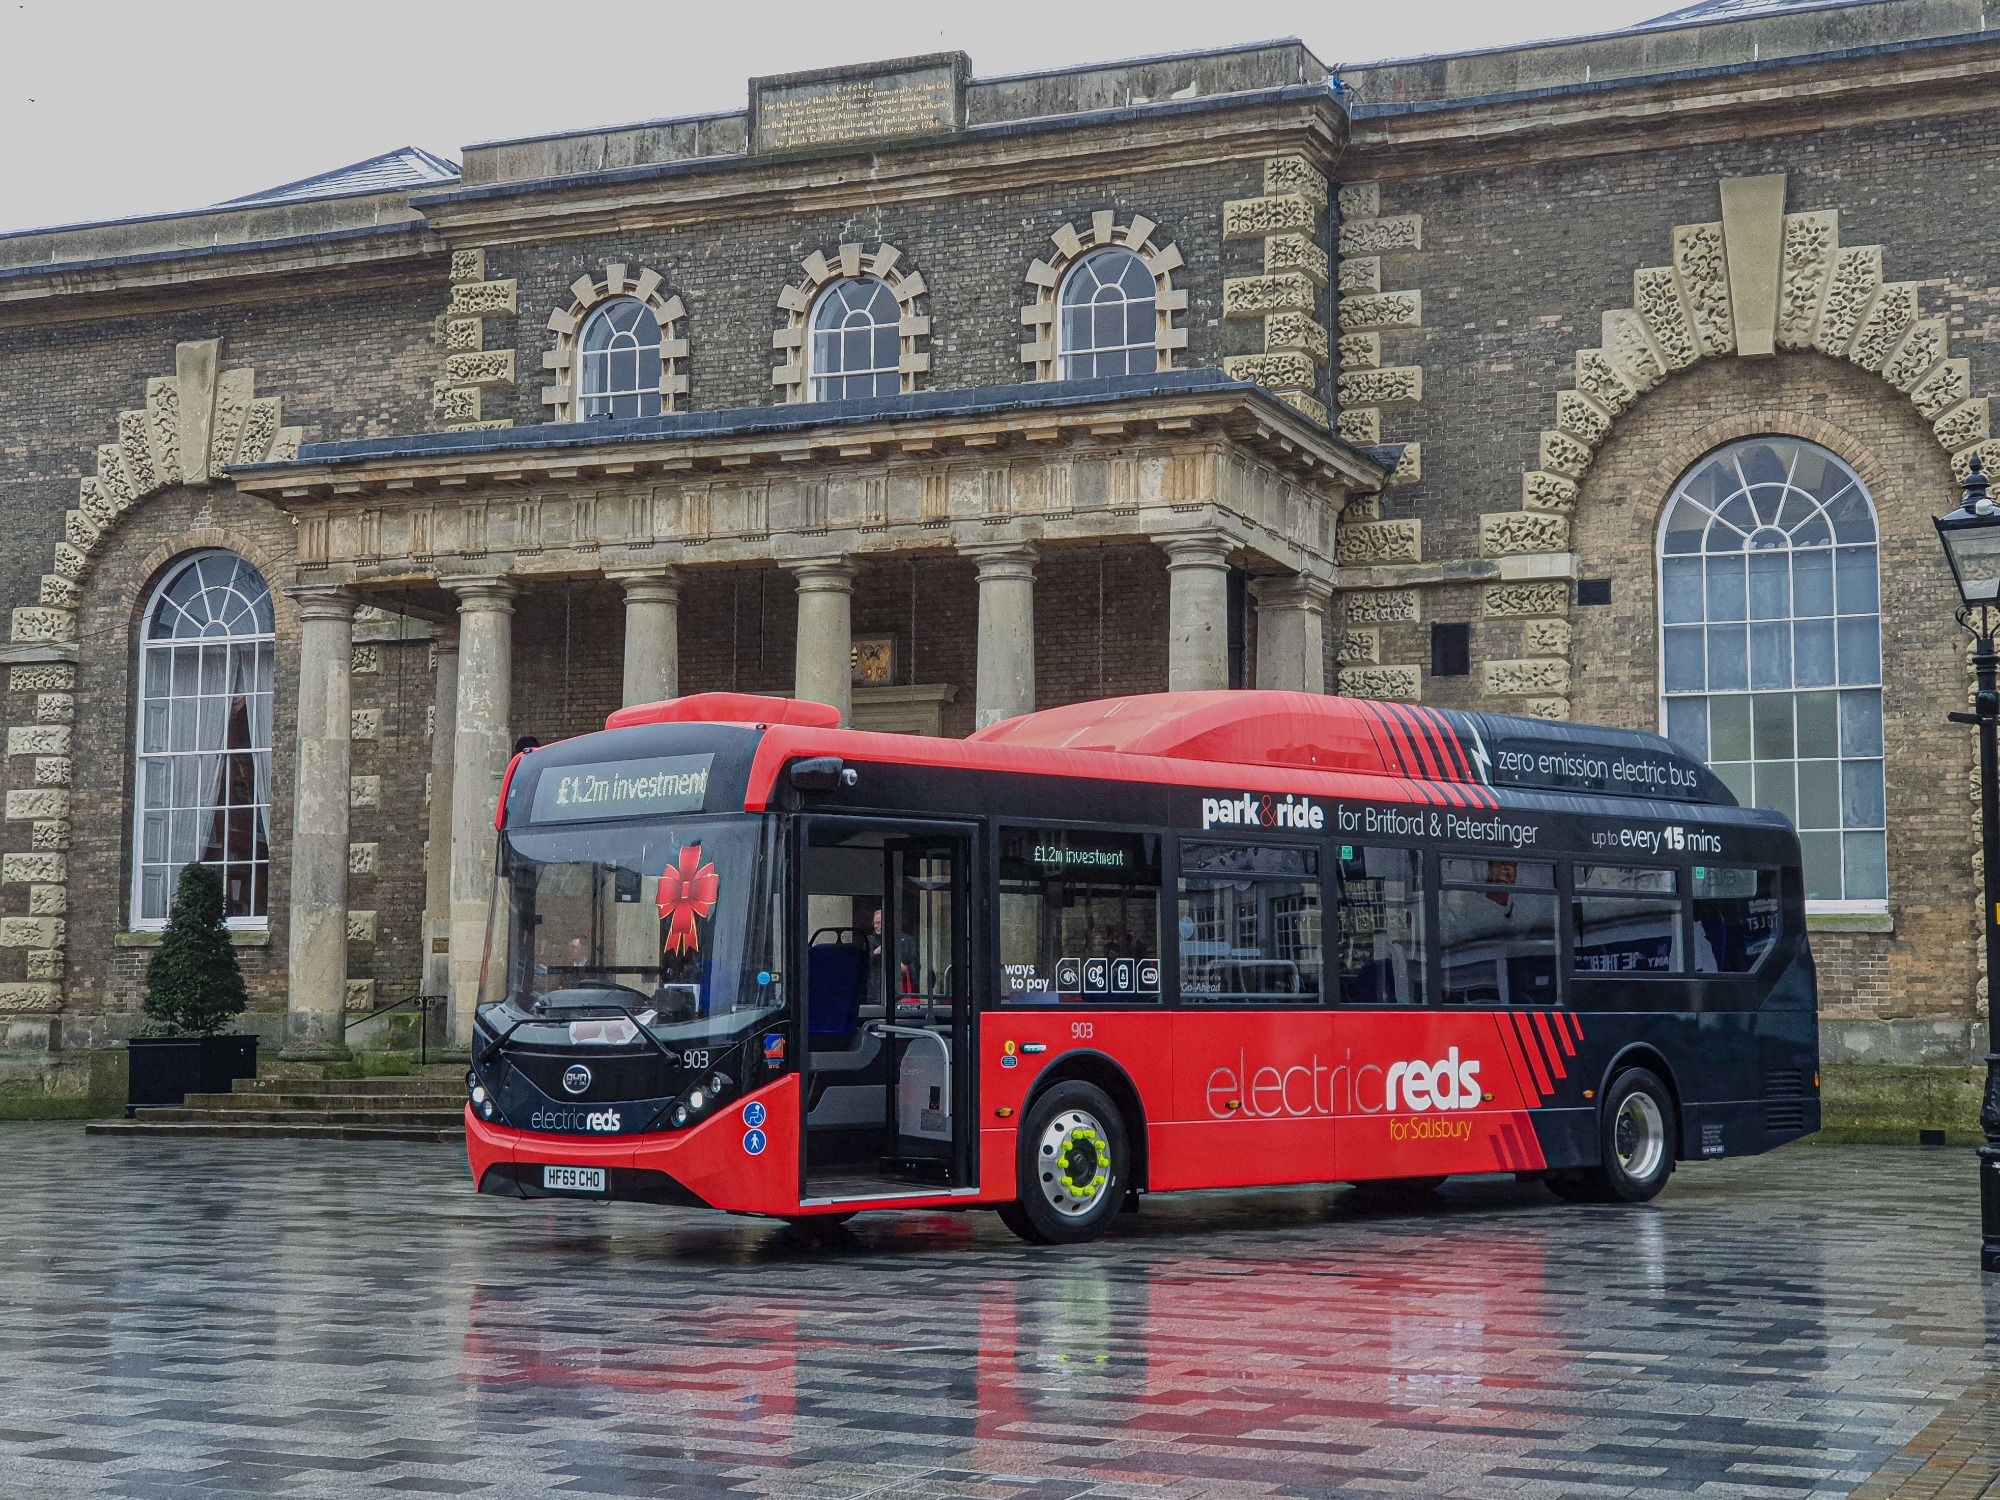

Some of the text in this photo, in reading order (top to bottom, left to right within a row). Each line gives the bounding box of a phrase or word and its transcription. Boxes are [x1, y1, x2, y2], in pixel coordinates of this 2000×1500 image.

[836, 81, 874, 93] Erected
[1497, 751, 1697, 788] zero emission electric bus
[557, 767, 709, 805] £1.2m investment
[1338, 804, 1362, 832] for
[1365, 806, 1425, 836] Britford
[1429, 811, 1442, 837] &
[1446, 813, 1539, 849] Petersfinger
[1592, 826, 1722, 854] up to every 15 mins
[1065, 847, 1124, 866] investment
[1005, 964, 1035, 978] ways
[1011, 976, 1049, 993] to pay
[1071, 1022, 1093, 1039] 903
[683, 1050, 709, 1069] 903
[1390, 1116, 1472, 1142] for Salisbury
[548, 1168, 600, 1187] HF69 CHO
